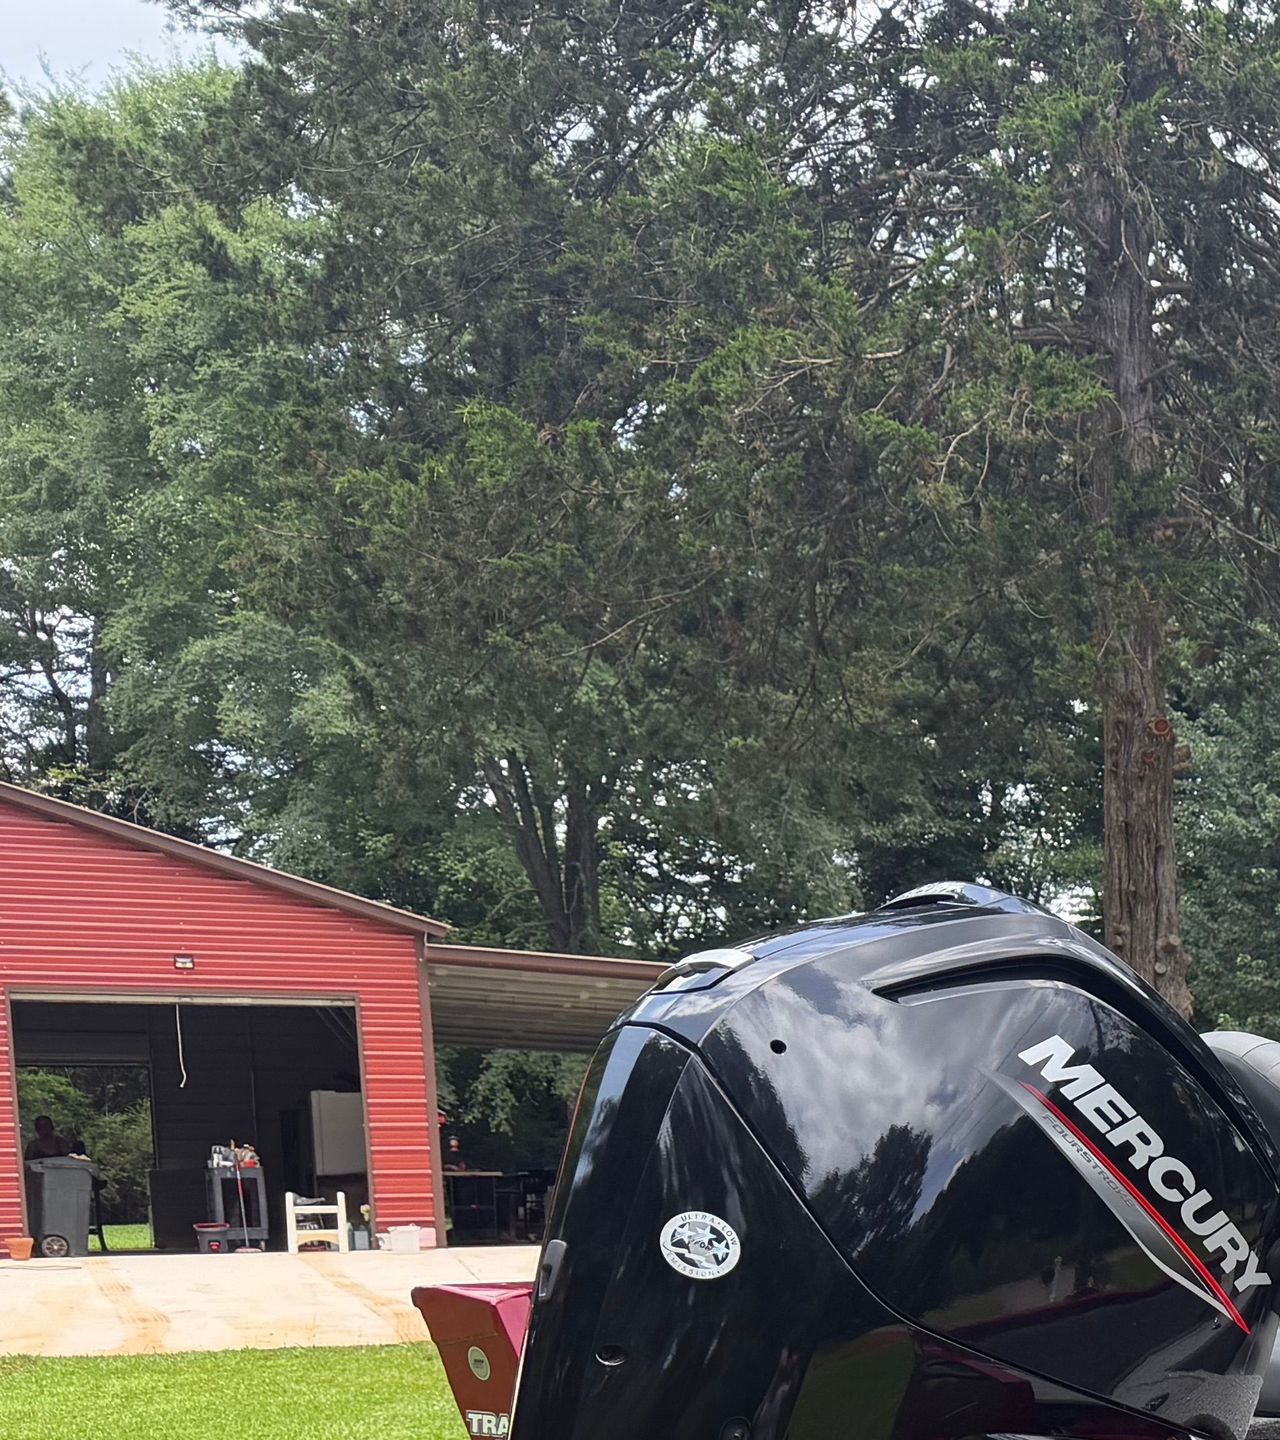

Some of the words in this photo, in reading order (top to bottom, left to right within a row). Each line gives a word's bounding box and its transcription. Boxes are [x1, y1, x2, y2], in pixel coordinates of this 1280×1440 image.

[1018, 1034, 1272, 1293] MERCURY
[1041, 1112, 1138, 1208] FOURSTROKE
[680, 1213, 716, 1225] ULTRA
